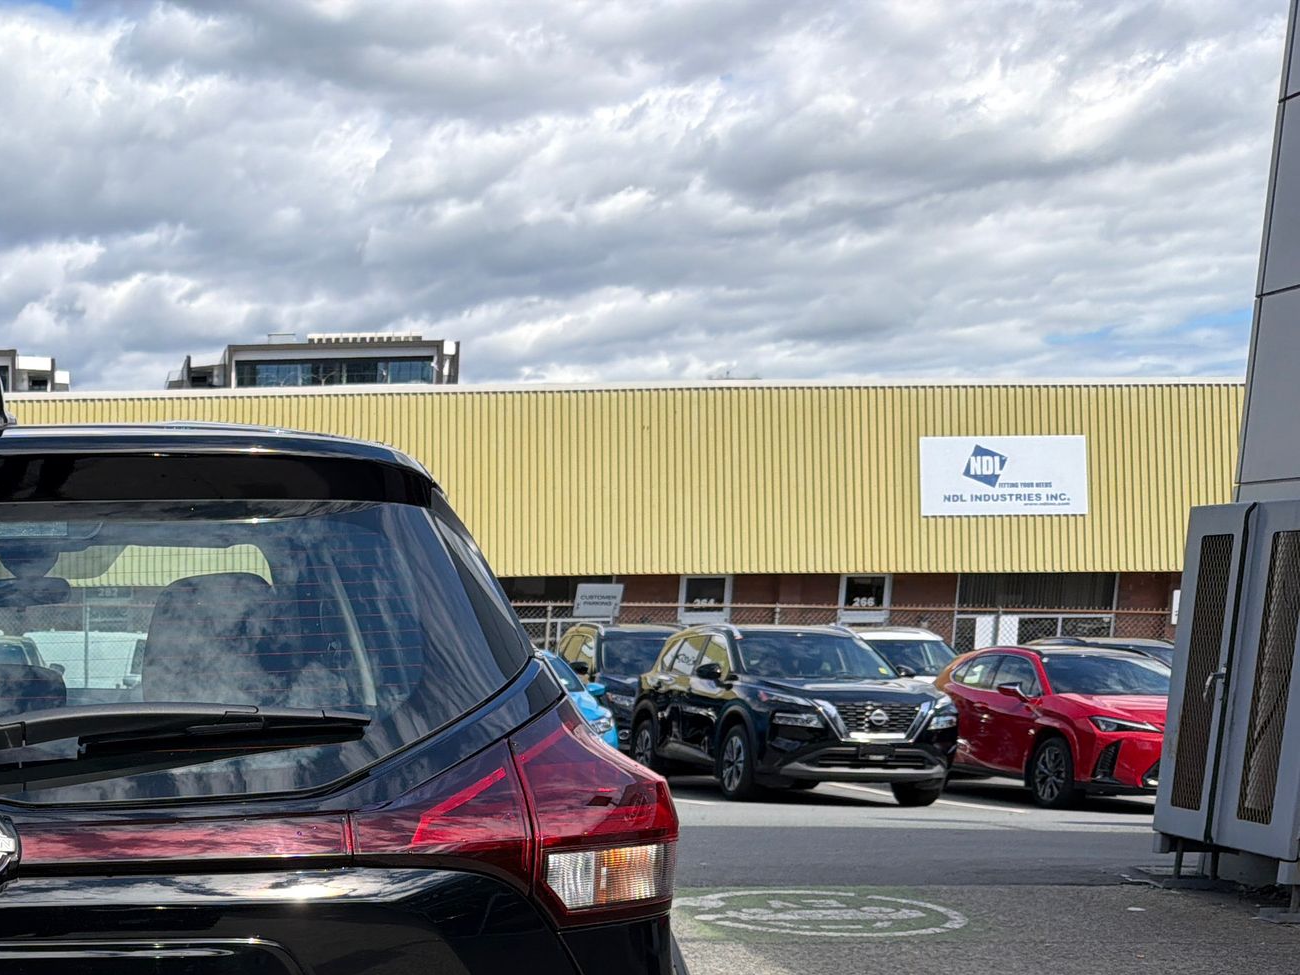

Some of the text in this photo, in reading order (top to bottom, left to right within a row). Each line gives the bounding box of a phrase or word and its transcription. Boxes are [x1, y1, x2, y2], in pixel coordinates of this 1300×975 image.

[970, 455, 1002, 476] NDL
[943, 492, 1071, 503] NDL INDUSTRIES INC.
[852, 596, 876, 607] 266
